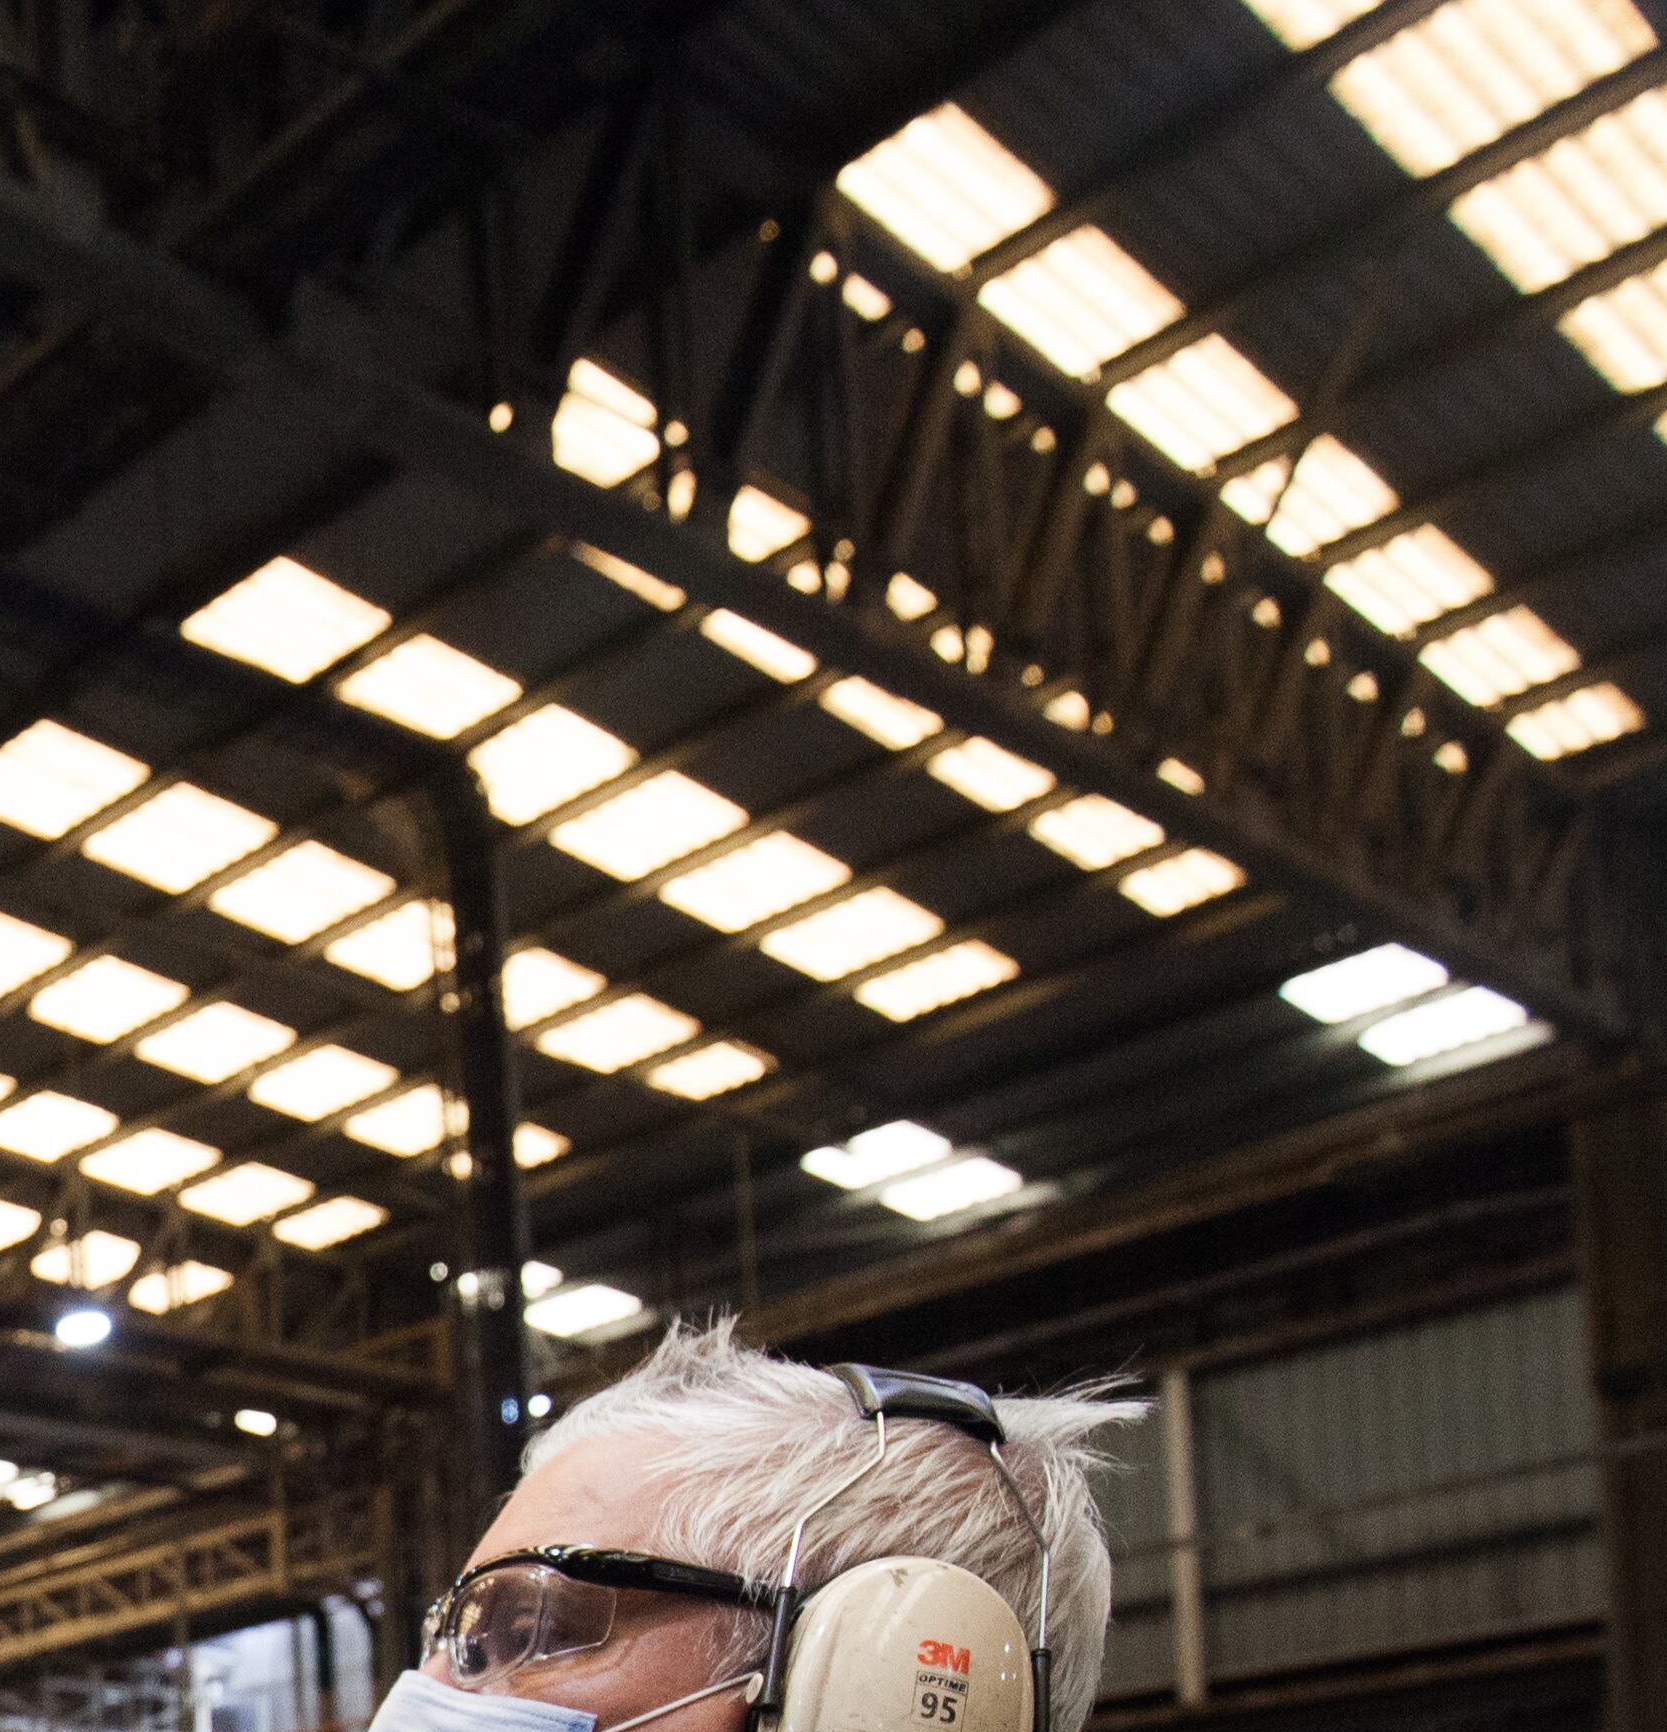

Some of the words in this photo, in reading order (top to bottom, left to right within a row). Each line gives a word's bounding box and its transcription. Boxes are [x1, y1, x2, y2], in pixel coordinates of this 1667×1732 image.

[917, 1639, 971, 1675] 3M
[918, 1675, 967, 1693] OPTIME
[920, 1692, 958, 1724] 95
